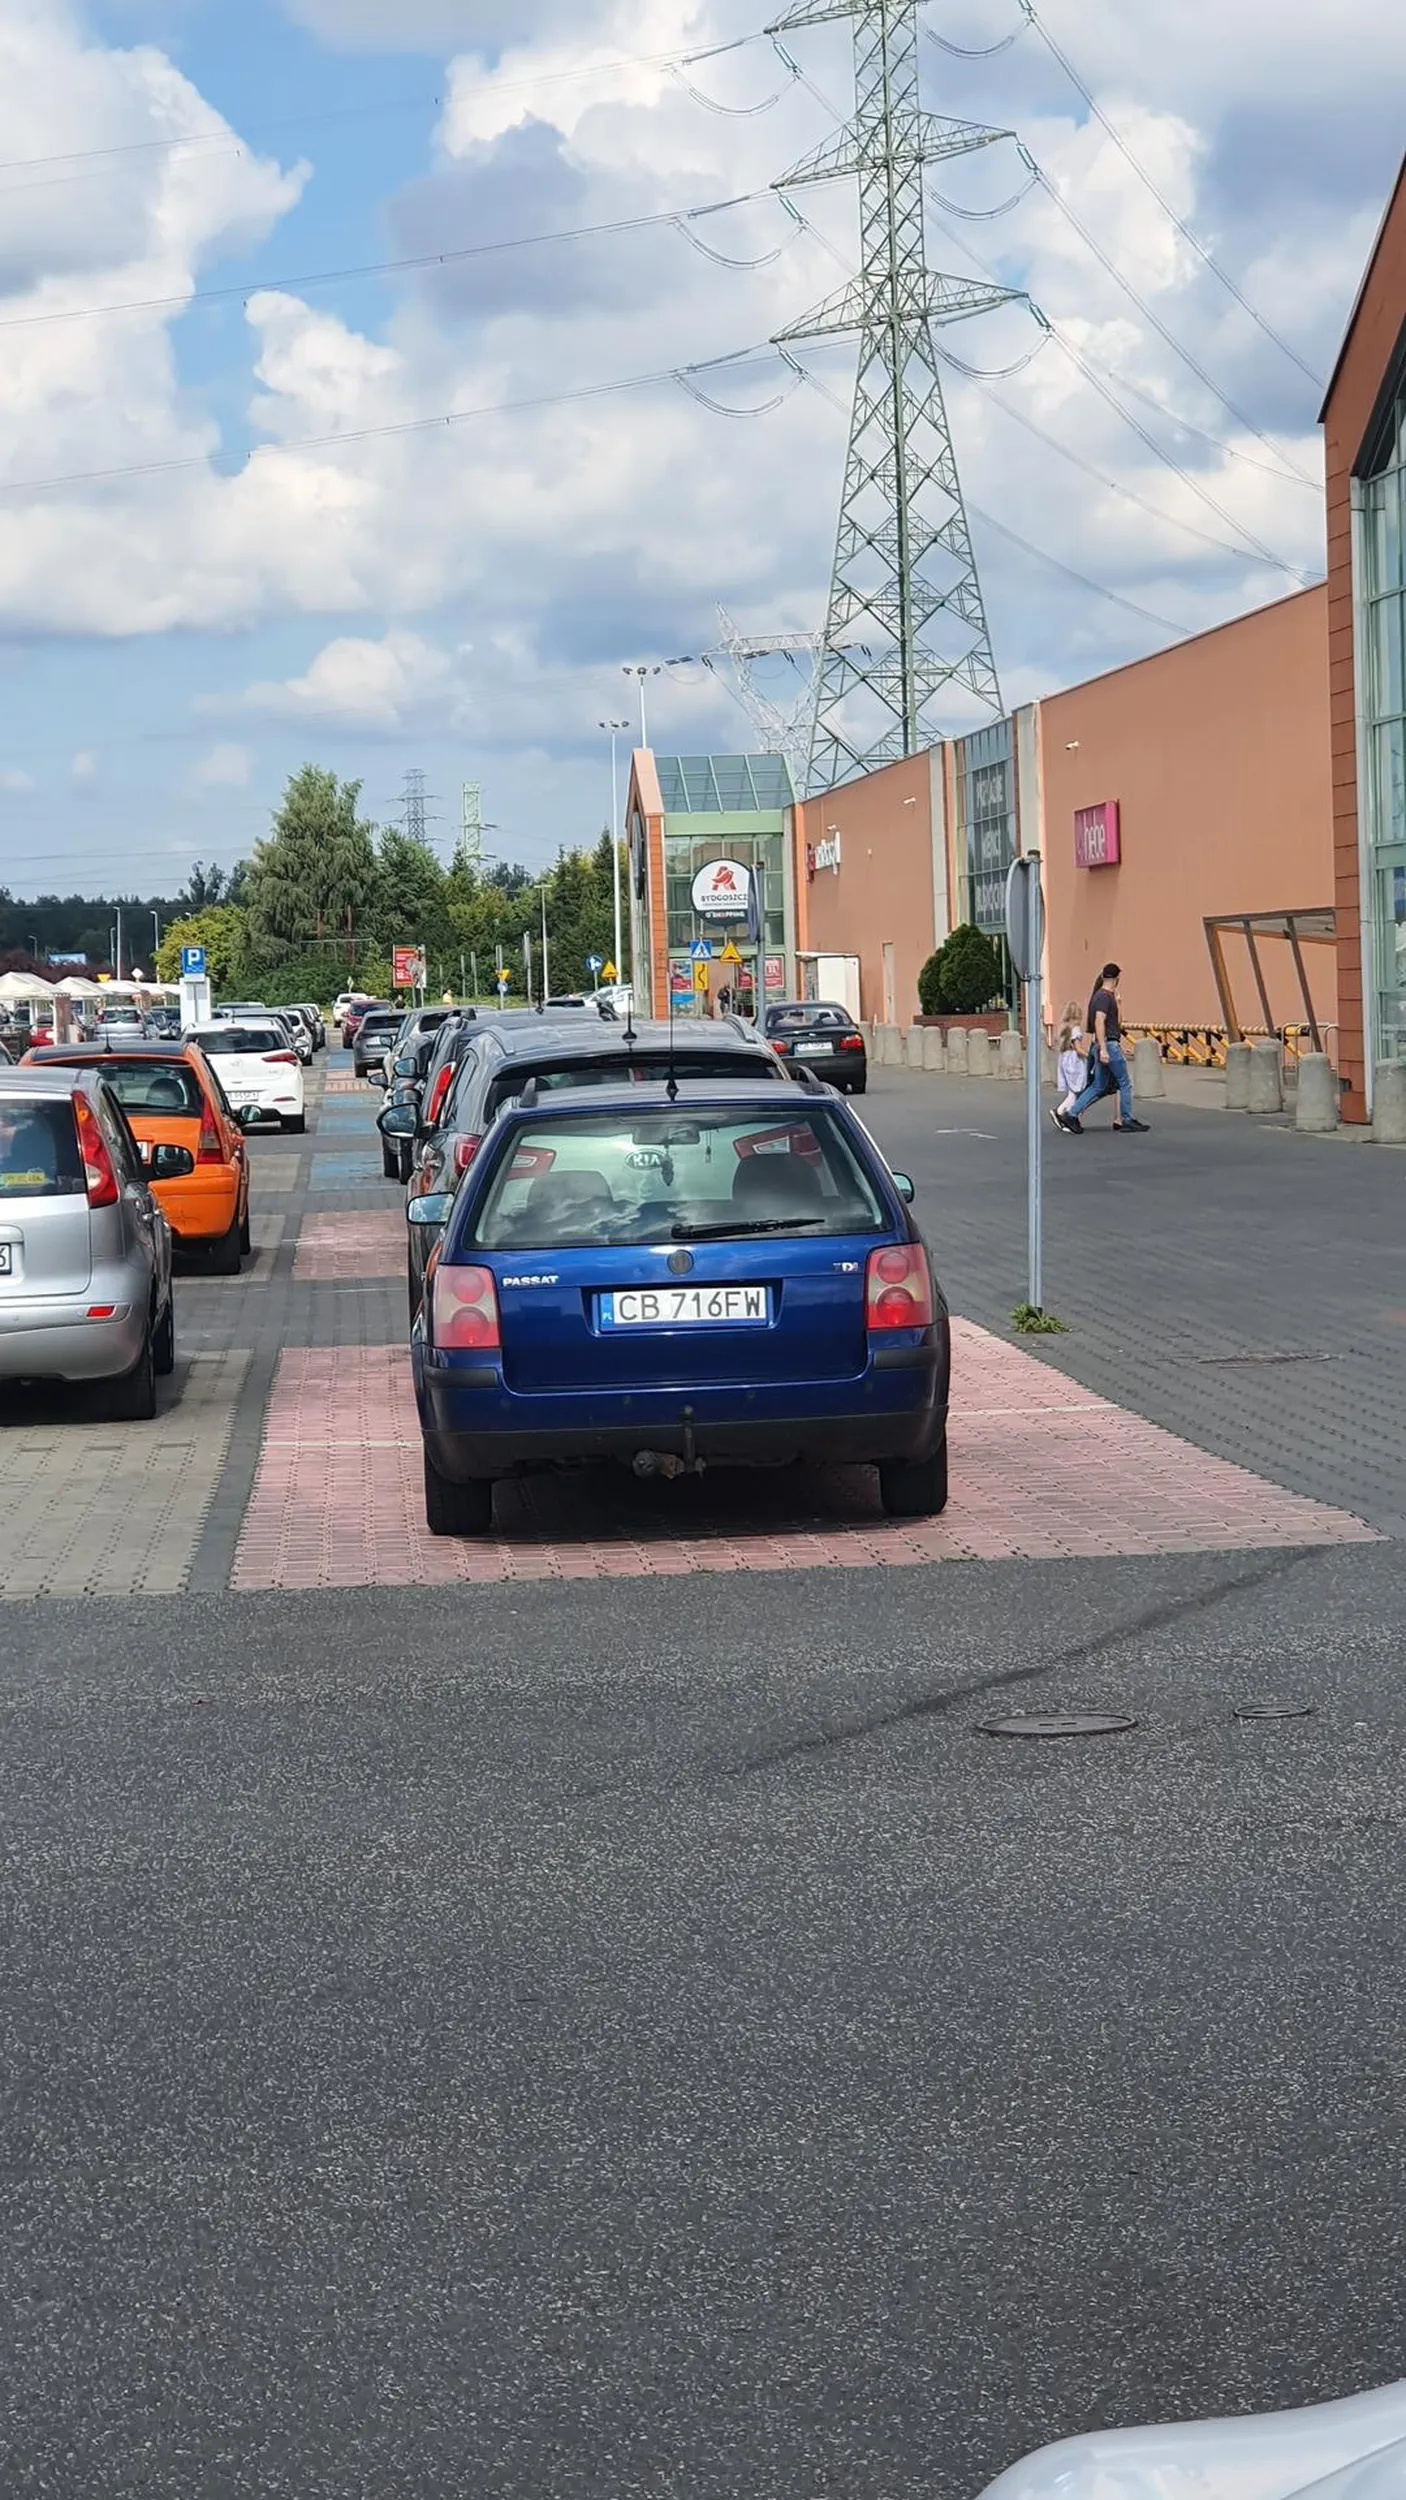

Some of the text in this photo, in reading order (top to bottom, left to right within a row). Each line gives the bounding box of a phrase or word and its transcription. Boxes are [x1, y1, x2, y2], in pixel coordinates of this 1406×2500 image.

[1083, 808, 1105, 860] hebe
[188, 949, 200, 966] P
[633, 1154, 660, 1167] KIA
[502, 1275, 559, 1287] PASSAT
[619, 1290, 761, 1321] CB 716FW
